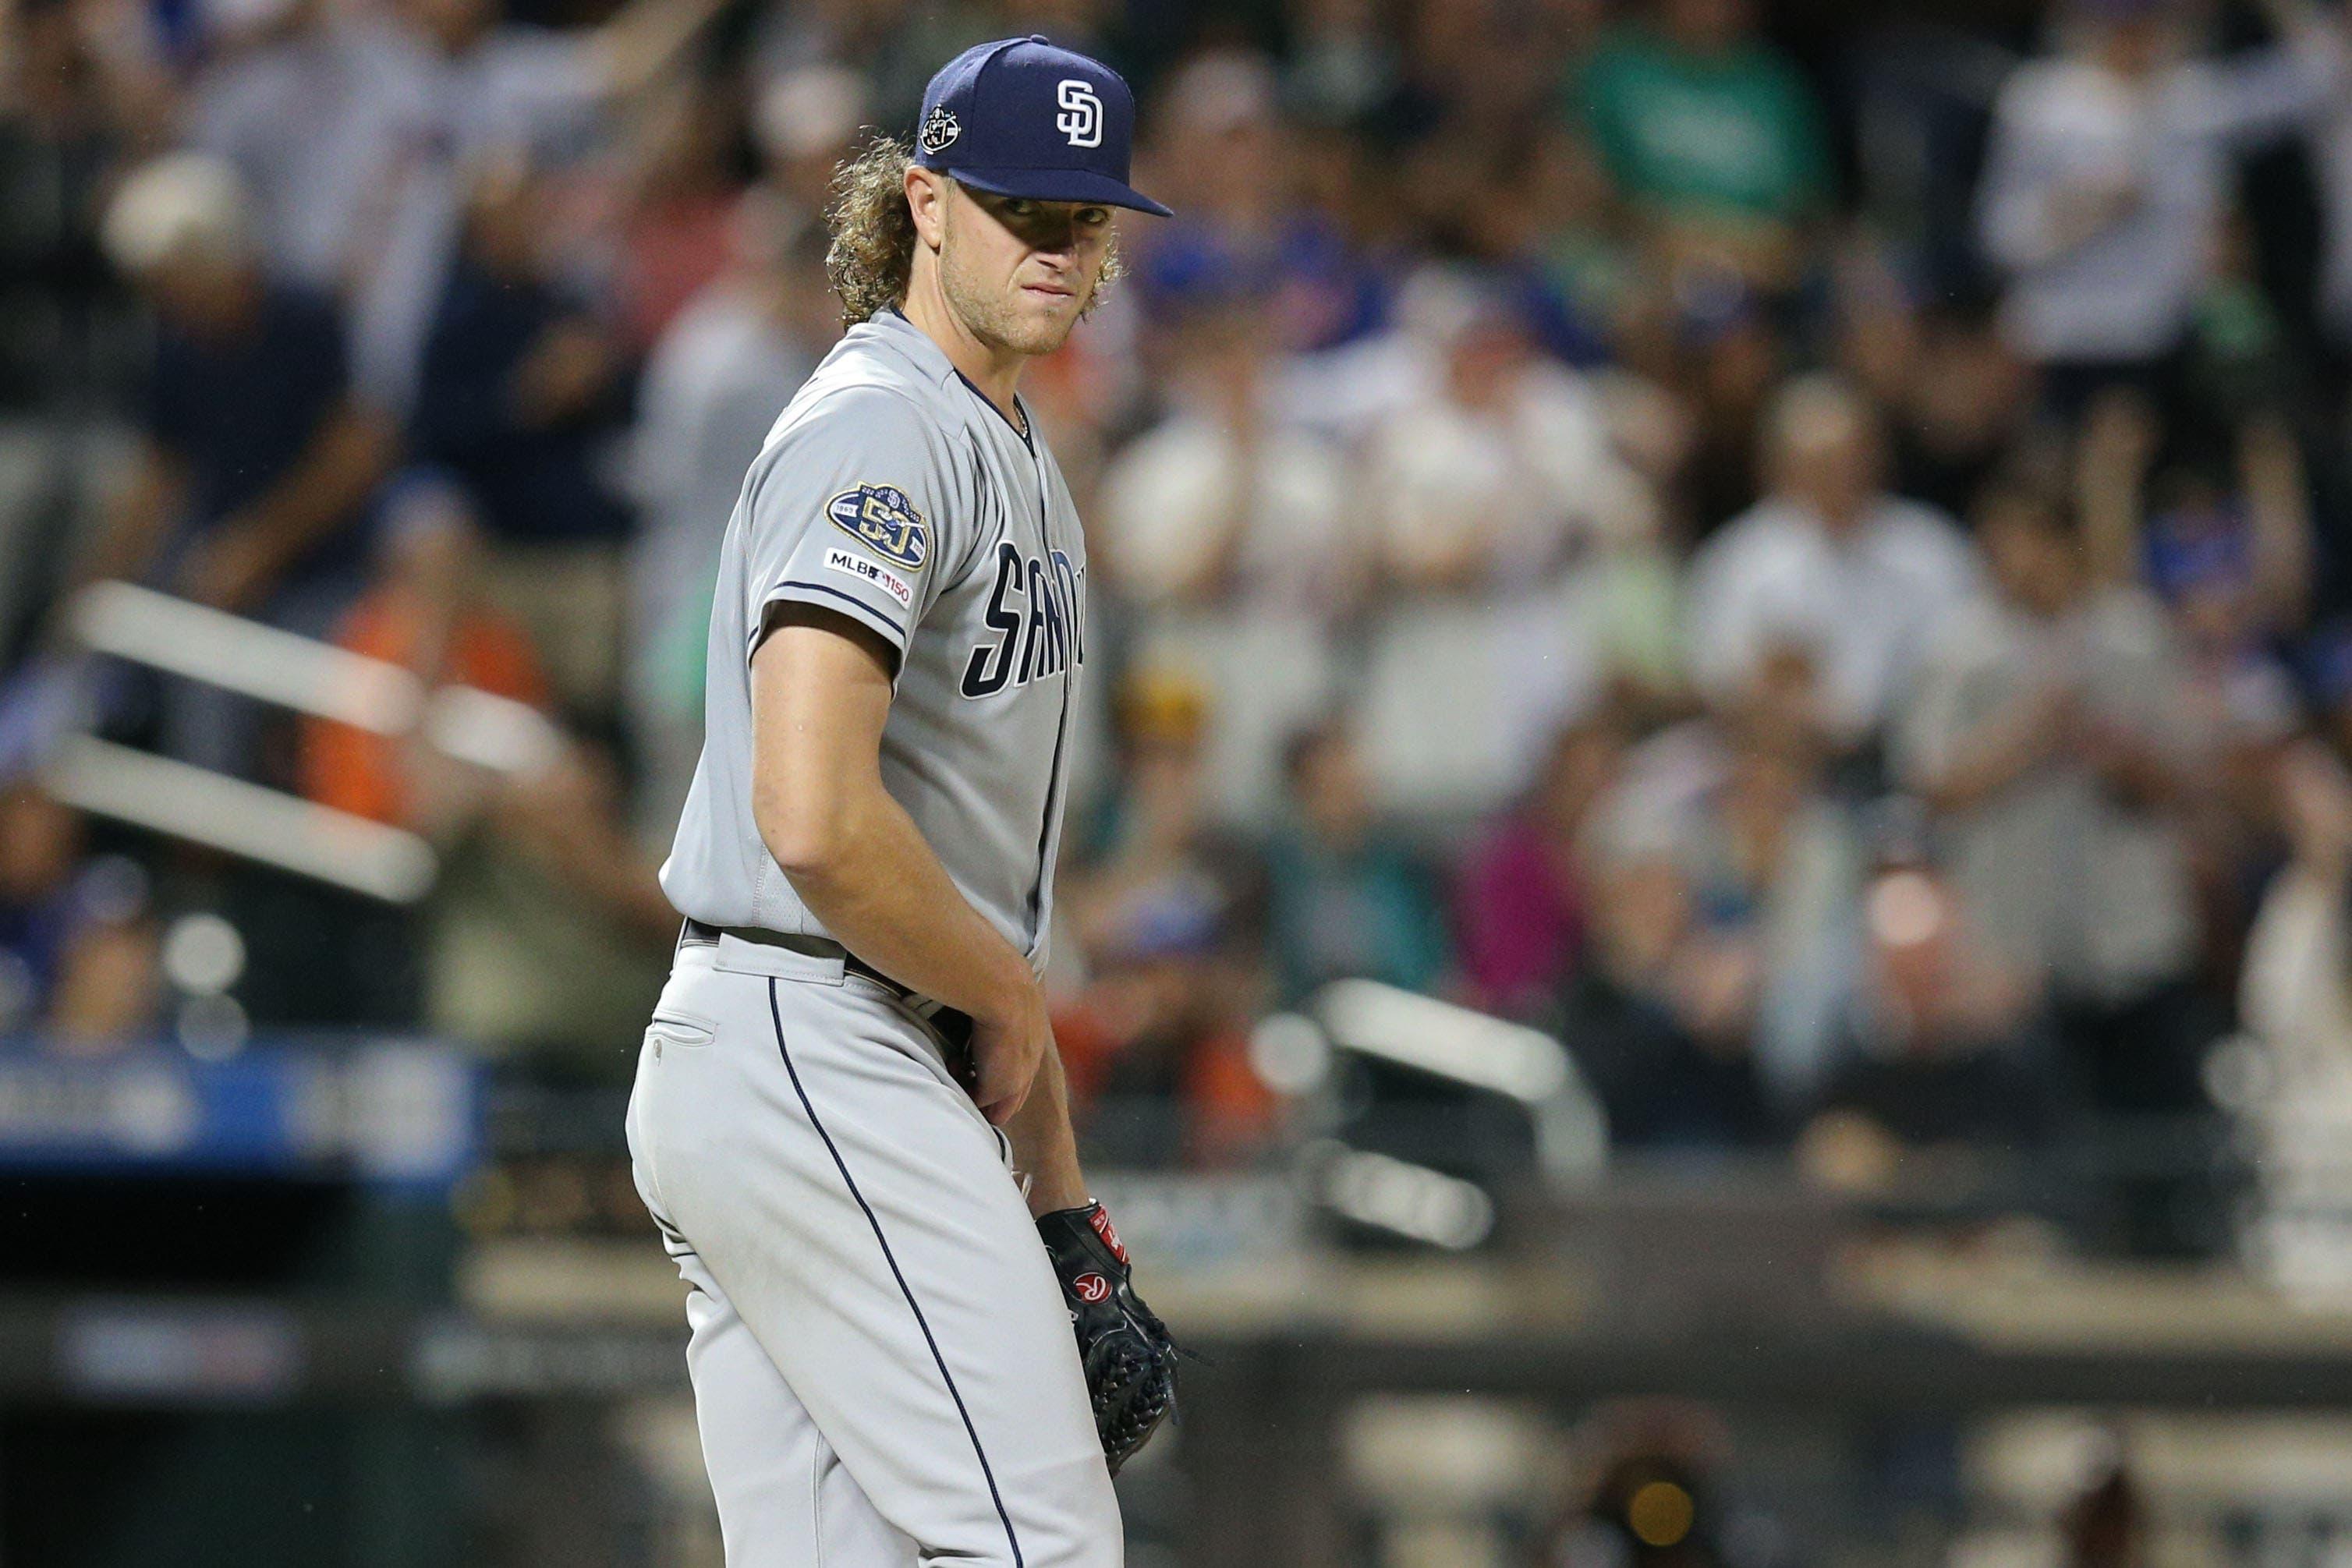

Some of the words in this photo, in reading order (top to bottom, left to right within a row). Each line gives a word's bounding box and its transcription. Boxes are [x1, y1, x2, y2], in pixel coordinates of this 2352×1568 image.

[1057, 79, 1103, 148] SD
[831, 552, 868, 575] MLB
[889, 578, 909, 603] 150
